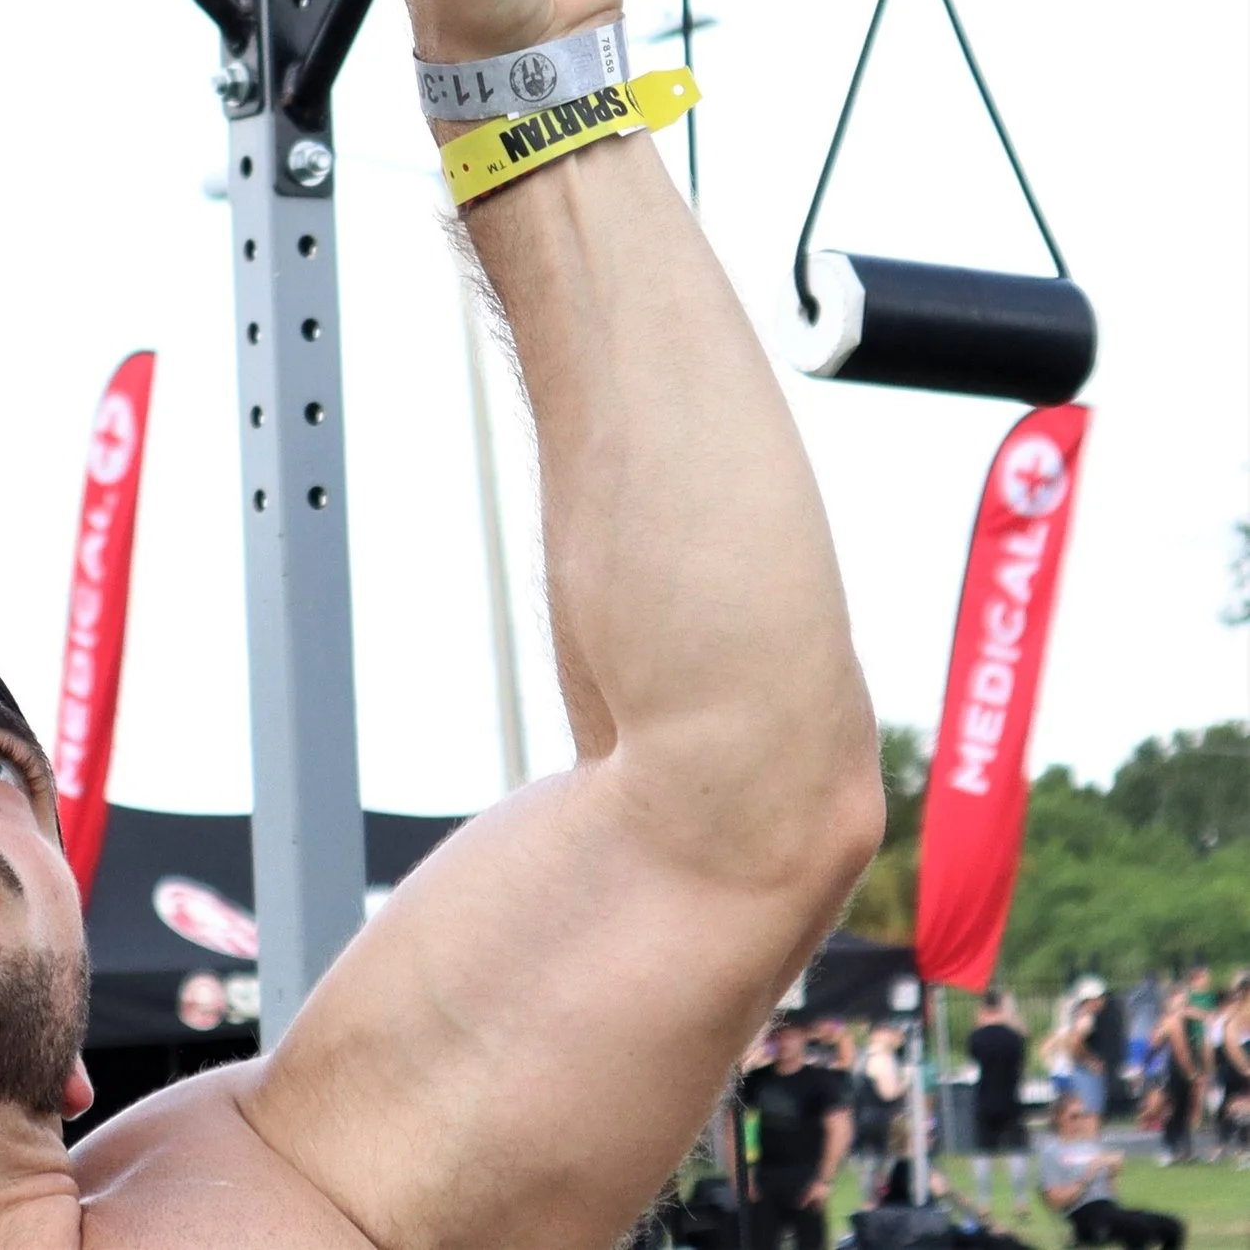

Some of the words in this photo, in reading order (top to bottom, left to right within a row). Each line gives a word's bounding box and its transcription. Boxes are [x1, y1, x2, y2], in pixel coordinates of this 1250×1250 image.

[600, 36, 616, 74] 78158
[499, 86, 628, 163] SPARTAN
[949, 522, 1051, 797] MEDICAL
